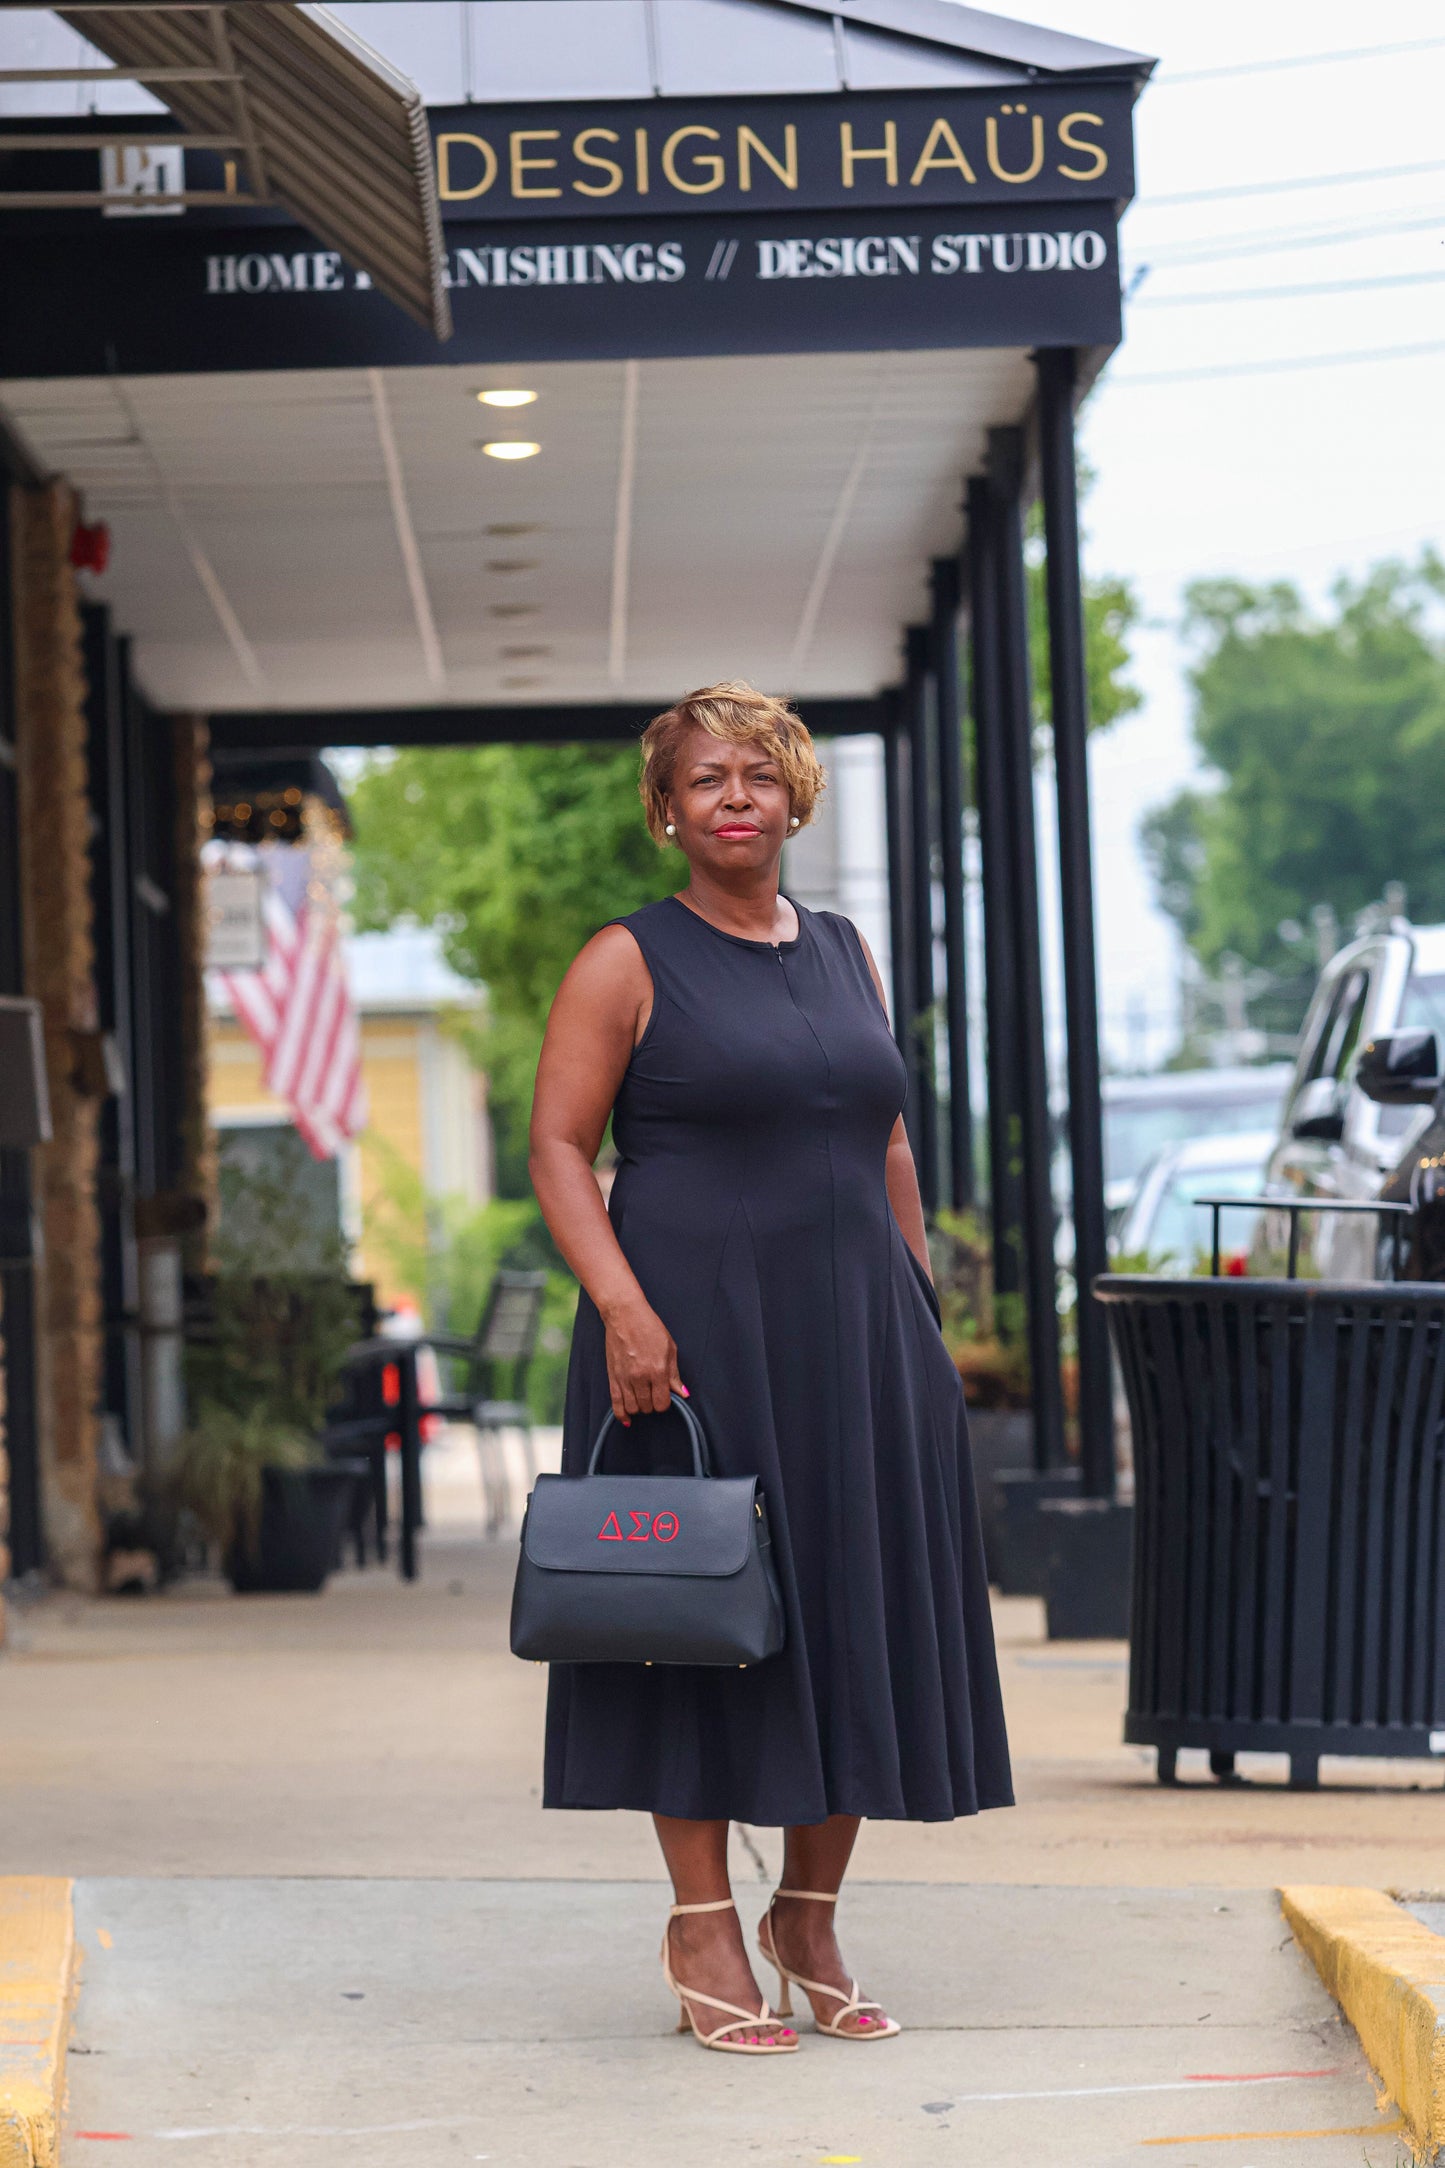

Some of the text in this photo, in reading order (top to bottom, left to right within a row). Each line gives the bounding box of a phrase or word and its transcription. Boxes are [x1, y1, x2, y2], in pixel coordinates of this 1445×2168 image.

[436, 103, 1109, 201] DESIGN HAÜS
[205, 252, 345, 294] HOME
[354, 242, 686, 290] NISHINGS
[756, 236, 922, 280] DESIGN
[931, 230, 1107, 274] STUDIO
[597, 1510, 680, 1543] ΔΣΘ
